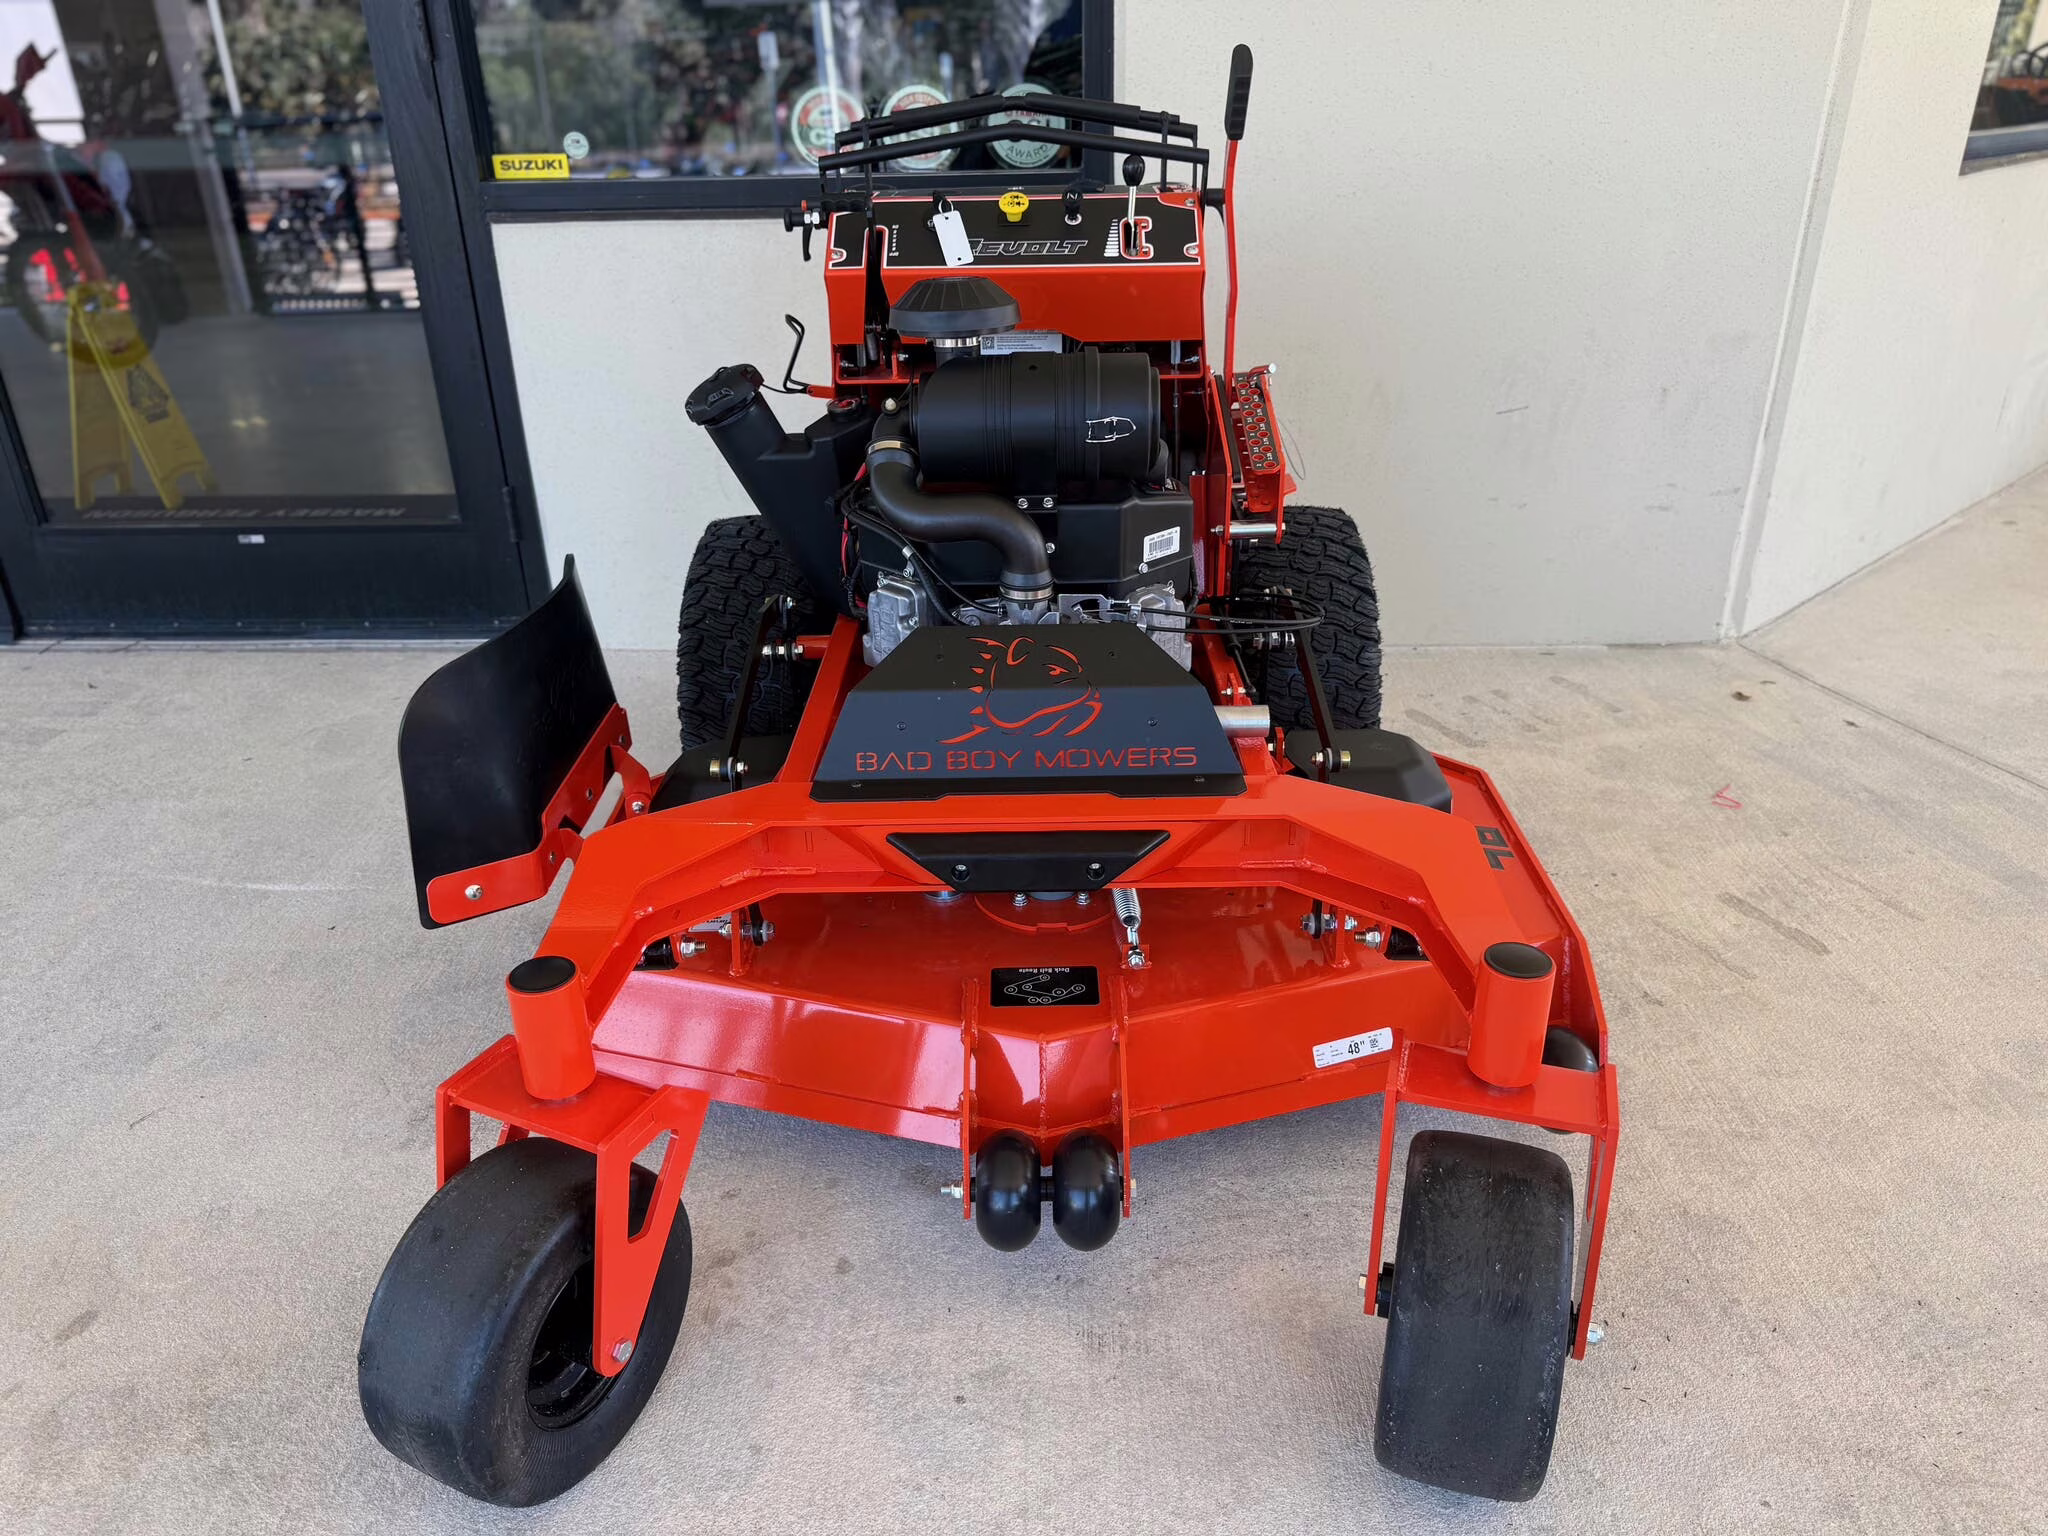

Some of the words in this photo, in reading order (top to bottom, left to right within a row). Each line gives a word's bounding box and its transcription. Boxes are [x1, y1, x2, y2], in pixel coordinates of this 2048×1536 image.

[1007, 144, 1048, 159] AWARD
[500, 159, 563, 170] SUZUKI
[856, 751, 932, 772] BAD
[946, 749, 1022, 771] BOY
[1035, 746, 1198, 769] MOWERS
[1347, 1040, 1365, 1055] 48"
